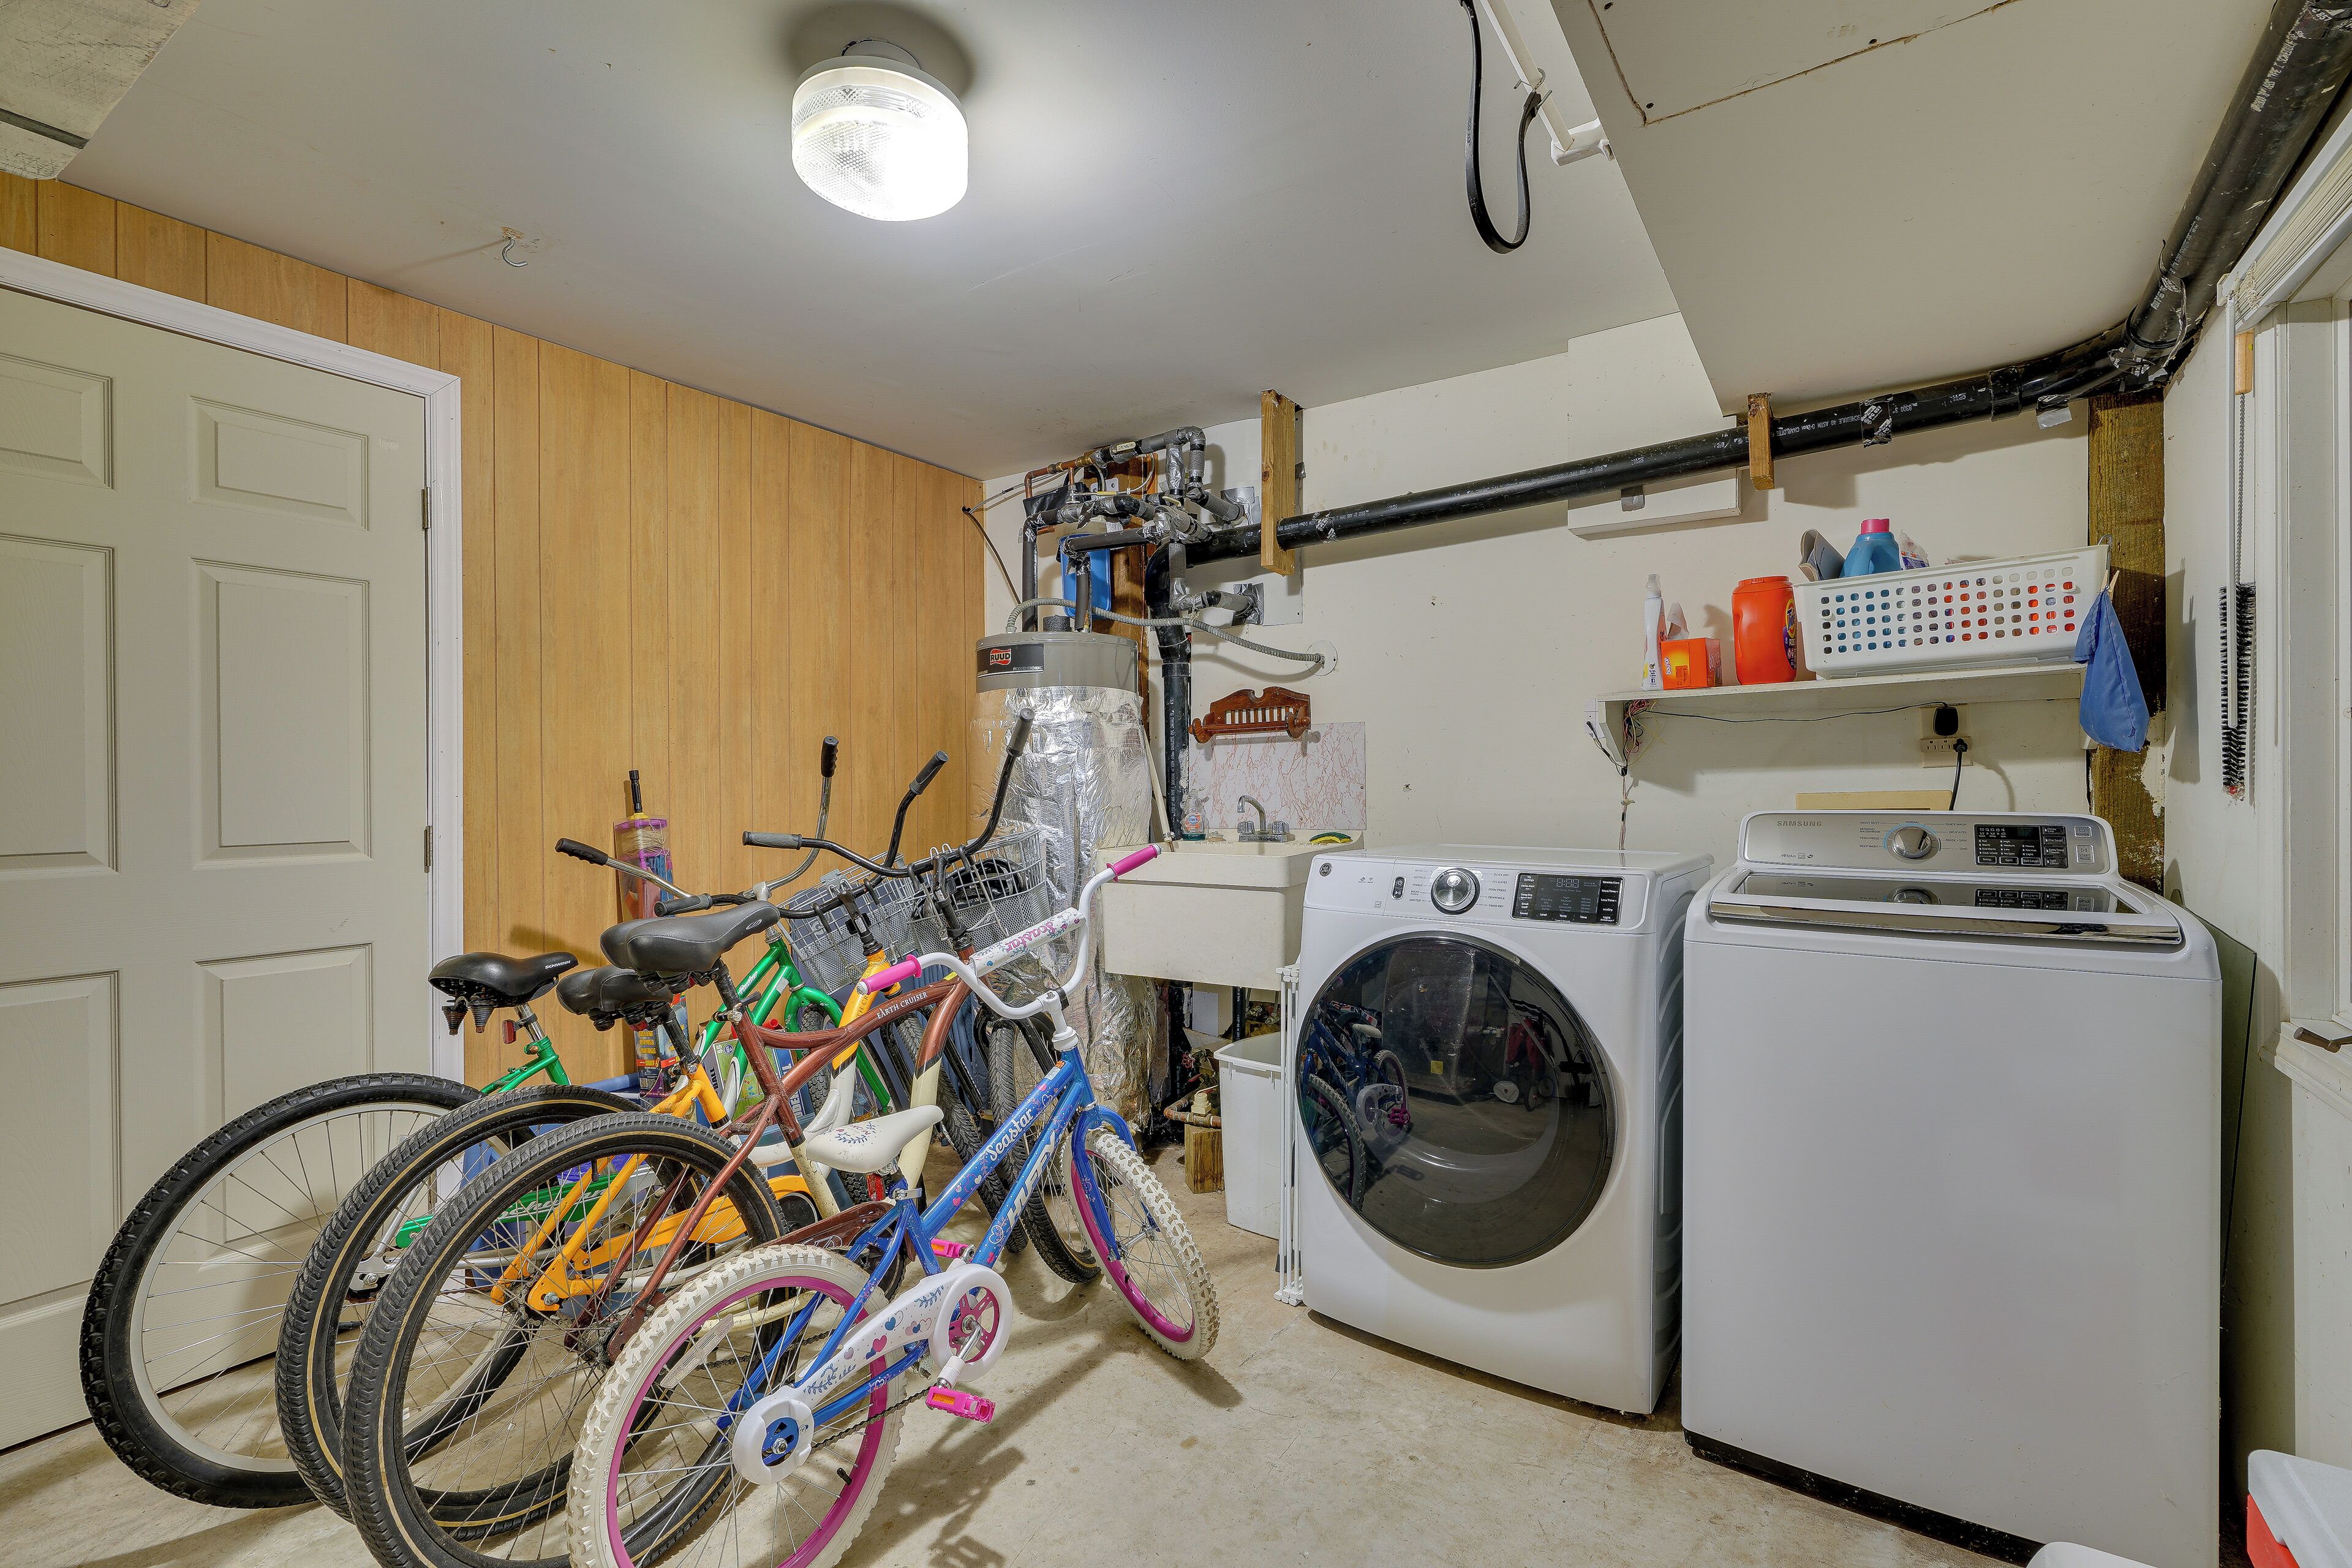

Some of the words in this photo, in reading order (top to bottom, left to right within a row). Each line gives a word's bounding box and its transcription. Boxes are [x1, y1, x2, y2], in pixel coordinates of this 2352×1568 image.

[1900, 404, 1913, 412] 8300
[1838, 414, 1861, 424] SCHEDULE
[1776, 426, 1800, 436] CHARLOTTE
[990, 652, 1011, 662] RUUD
[1005, 921, 1056, 954] Seastar
[876, 1005, 900, 1020] EARTH
[900, 991, 929, 1008] CRUISER
[985, 1107, 1033, 1161] Seastar
[1006, 1129, 1056, 1226] HUFFY
